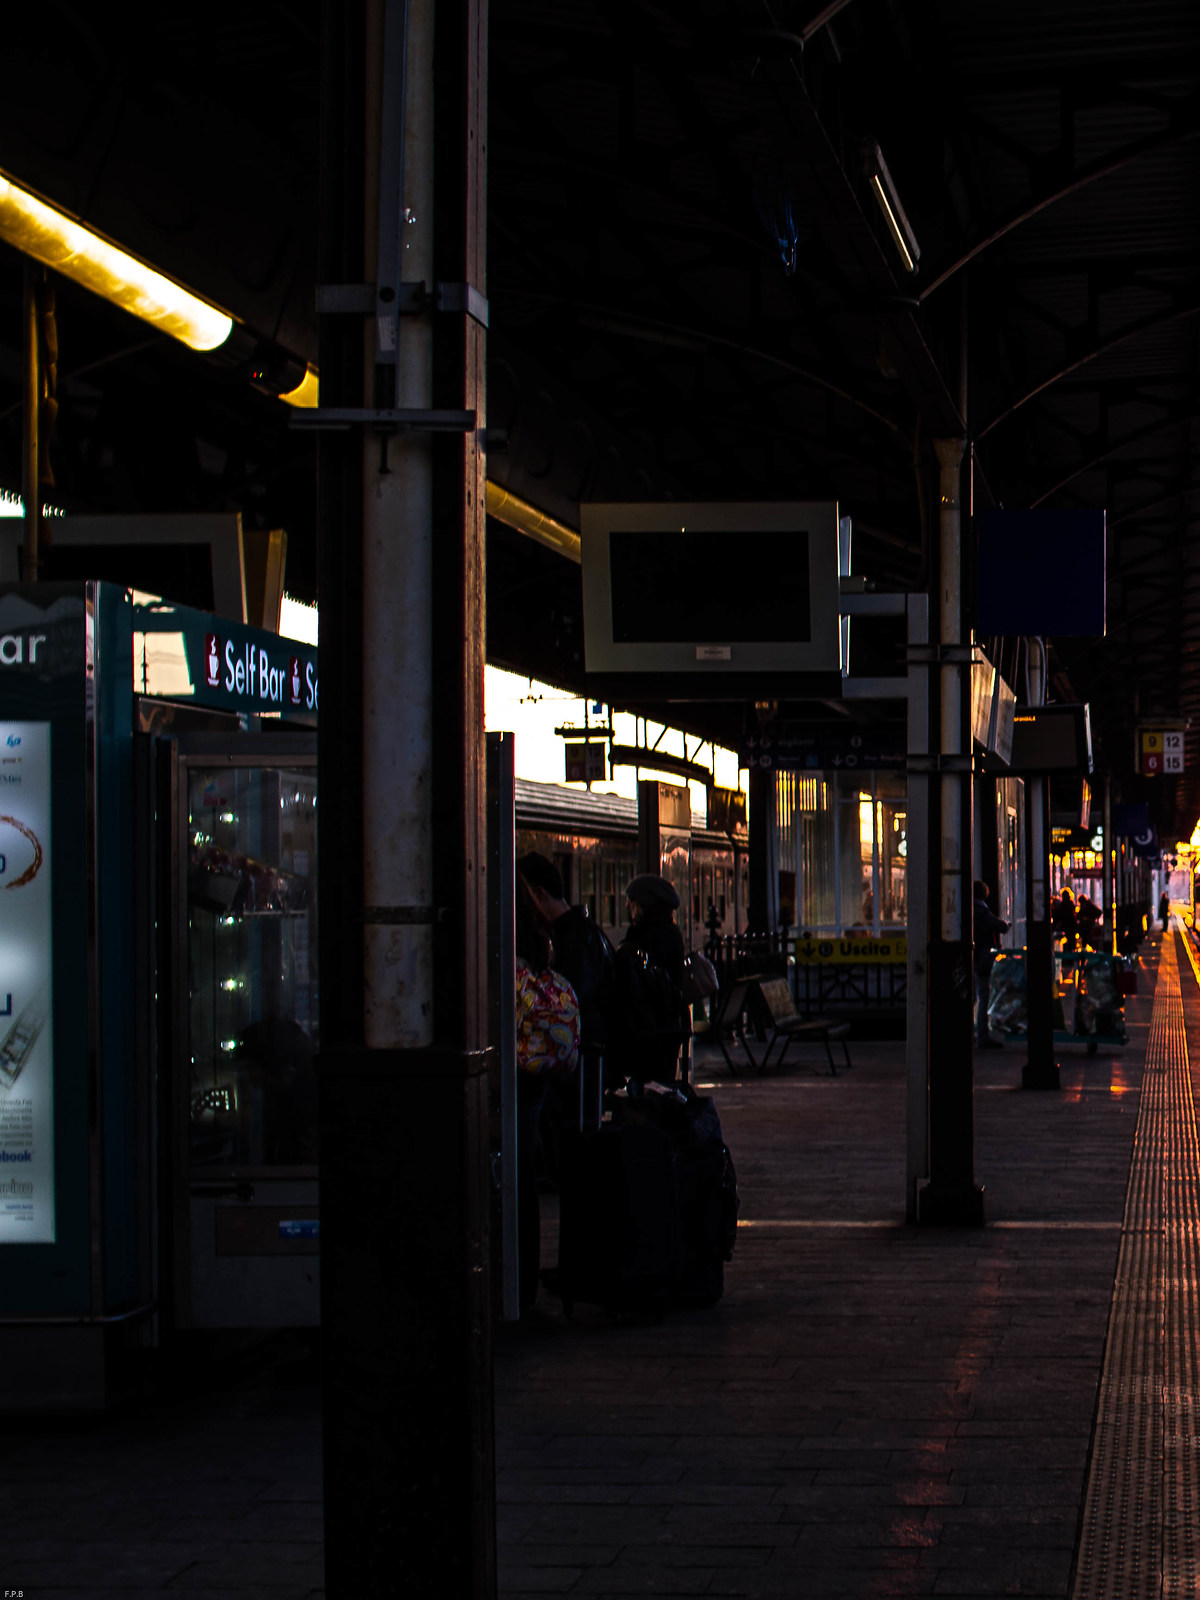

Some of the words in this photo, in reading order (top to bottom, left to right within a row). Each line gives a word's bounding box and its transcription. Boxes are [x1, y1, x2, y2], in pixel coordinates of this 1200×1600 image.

[1148, 735, 1157, 748] 9
[1166, 736, 1180, 748] 12
[1148, 756, 1158, 769] 6
[1166, 757, 1180, 769] 15
[840, 942, 890, 956] Uscita
